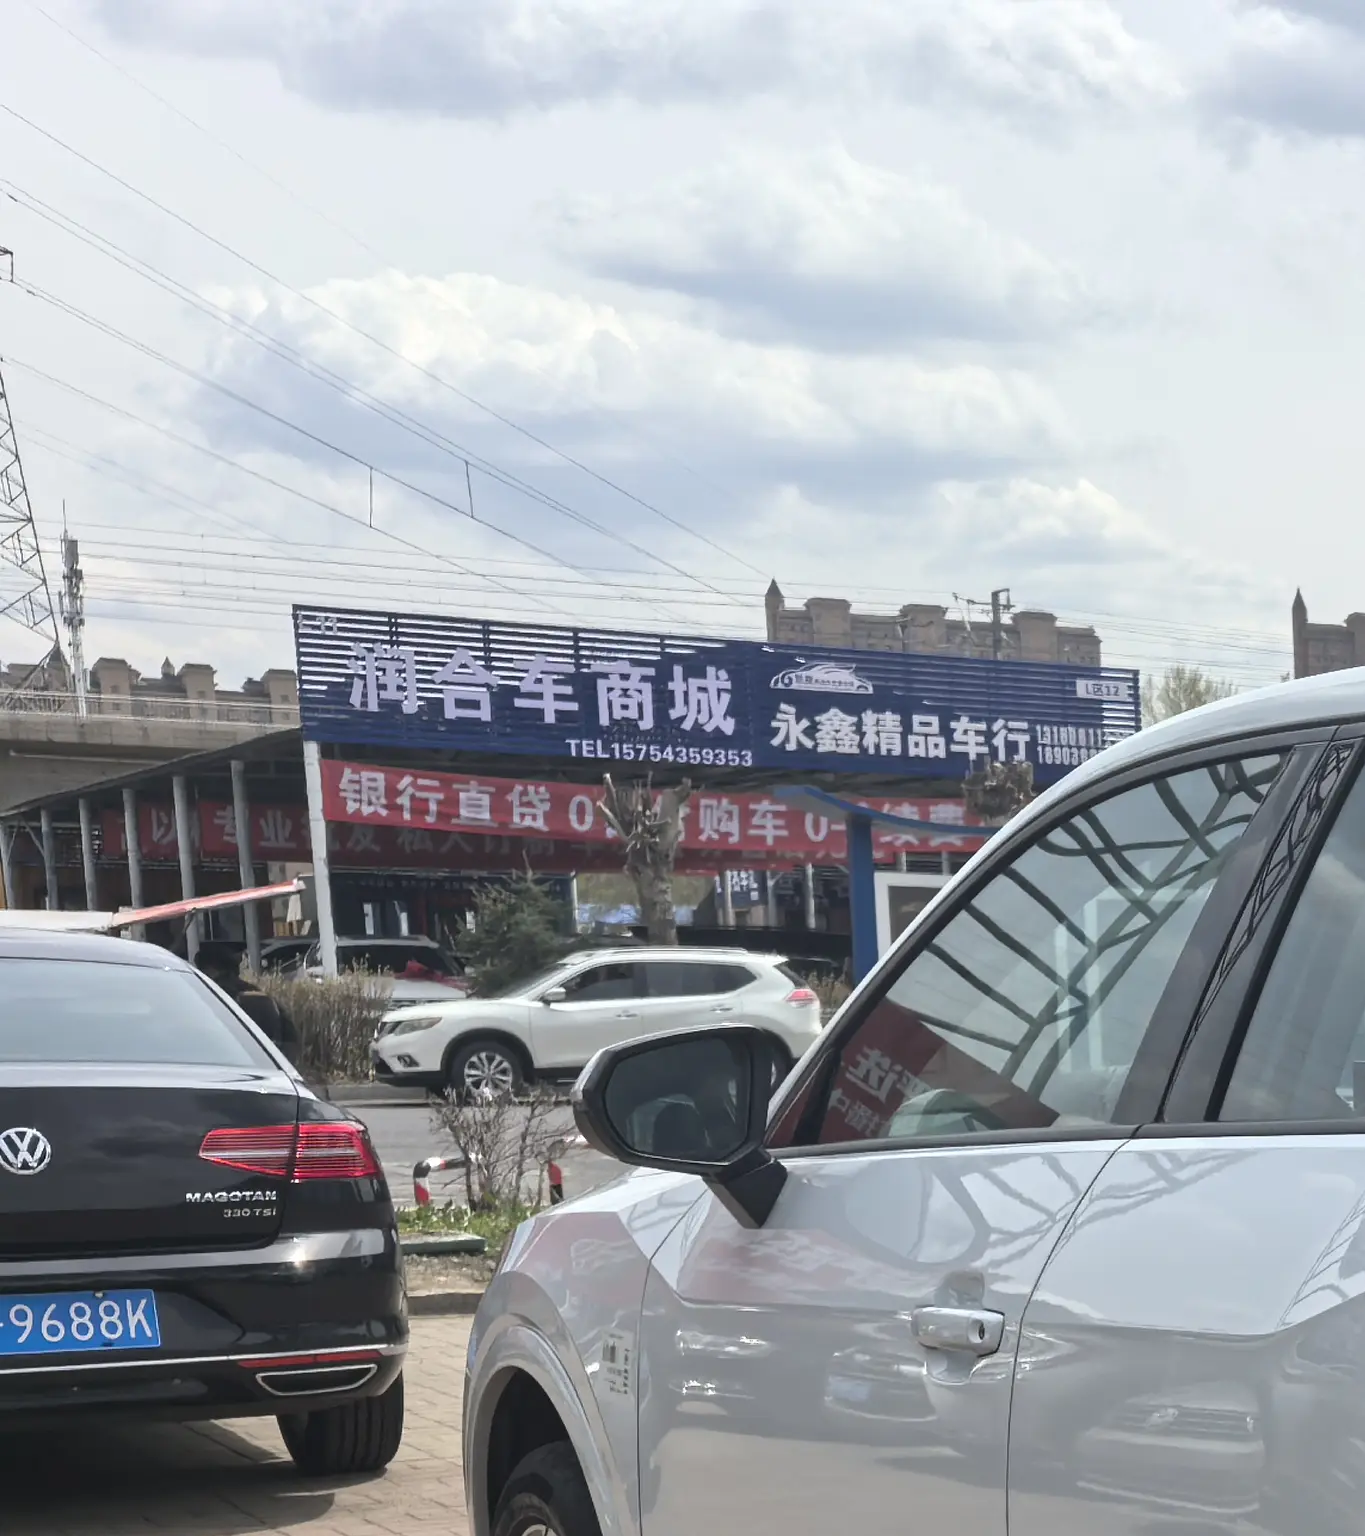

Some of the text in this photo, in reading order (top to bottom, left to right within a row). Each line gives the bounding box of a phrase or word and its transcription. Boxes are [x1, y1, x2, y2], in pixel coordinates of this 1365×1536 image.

[347, 641, 736, 736] 润合车商城
[770, 702, 1031, 762] 永鑫精品车行
[339, 767, 551, 833] 银行直贷
[568, 794, 790, 846] 0购车
[185, 1190, 278, 1203] MAGOTAN
